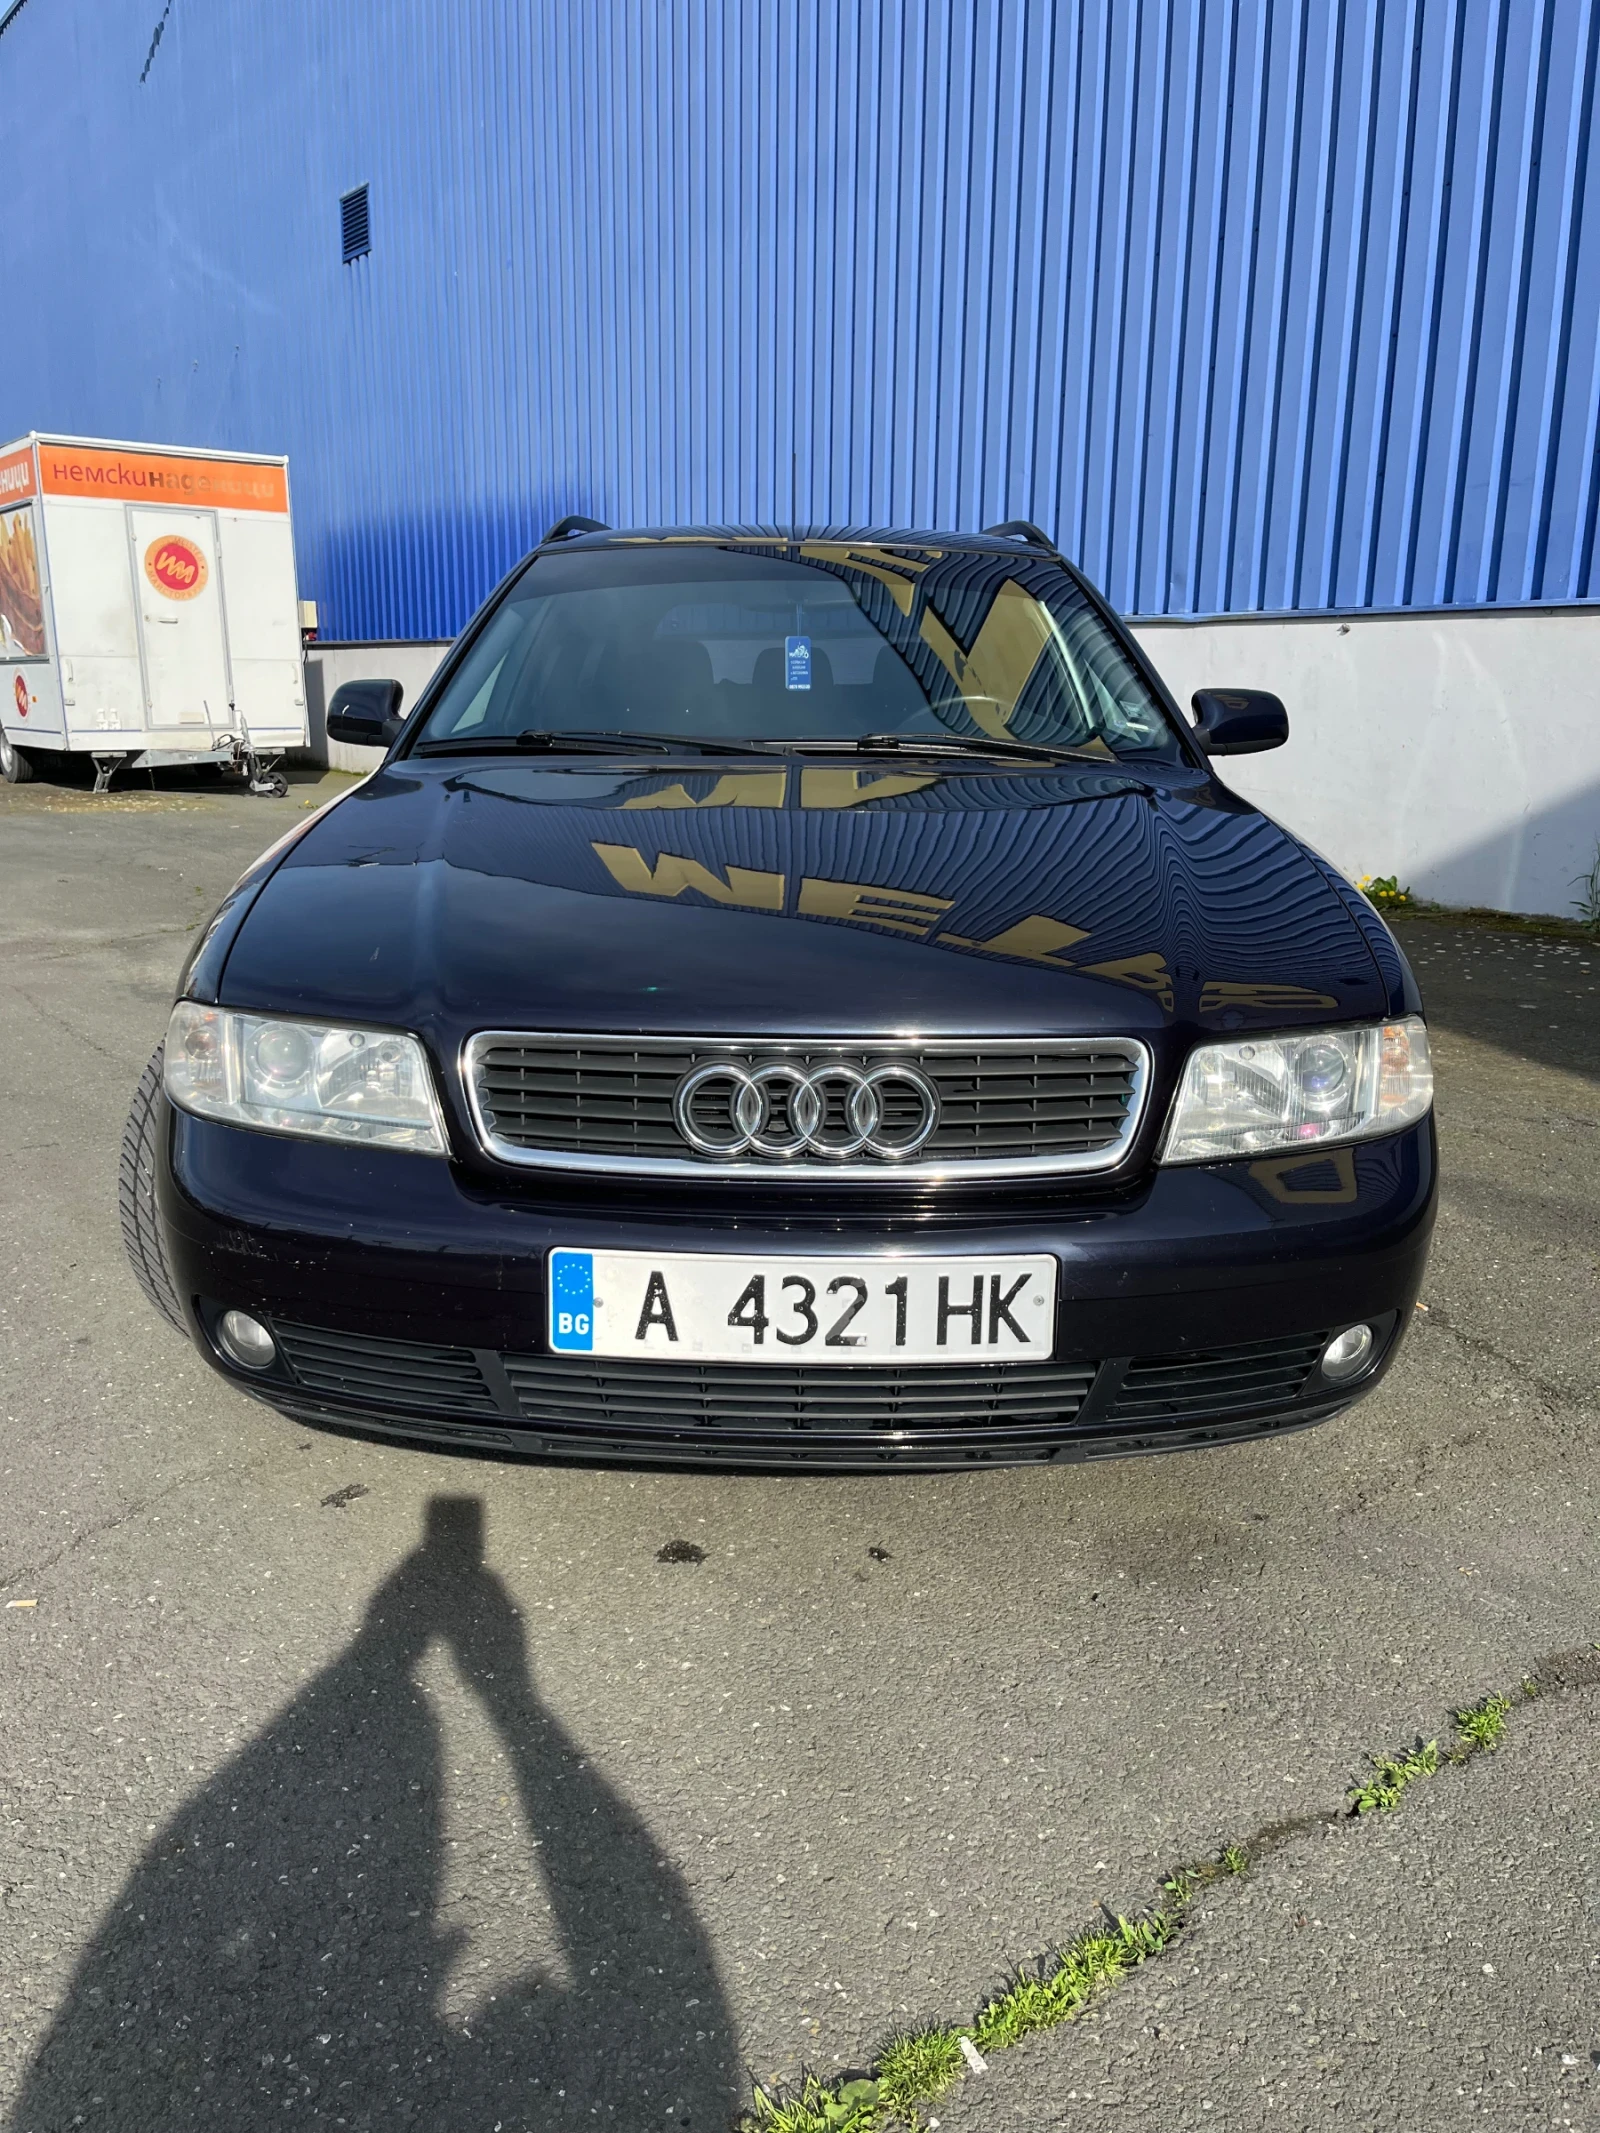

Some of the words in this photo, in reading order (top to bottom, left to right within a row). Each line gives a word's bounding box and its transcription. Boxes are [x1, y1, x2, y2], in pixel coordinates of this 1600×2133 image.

[558, 1313, 589, 1334] BG
[635, 1271, 679, 1342] A
[727, 1275, 909, 1347] 4321
